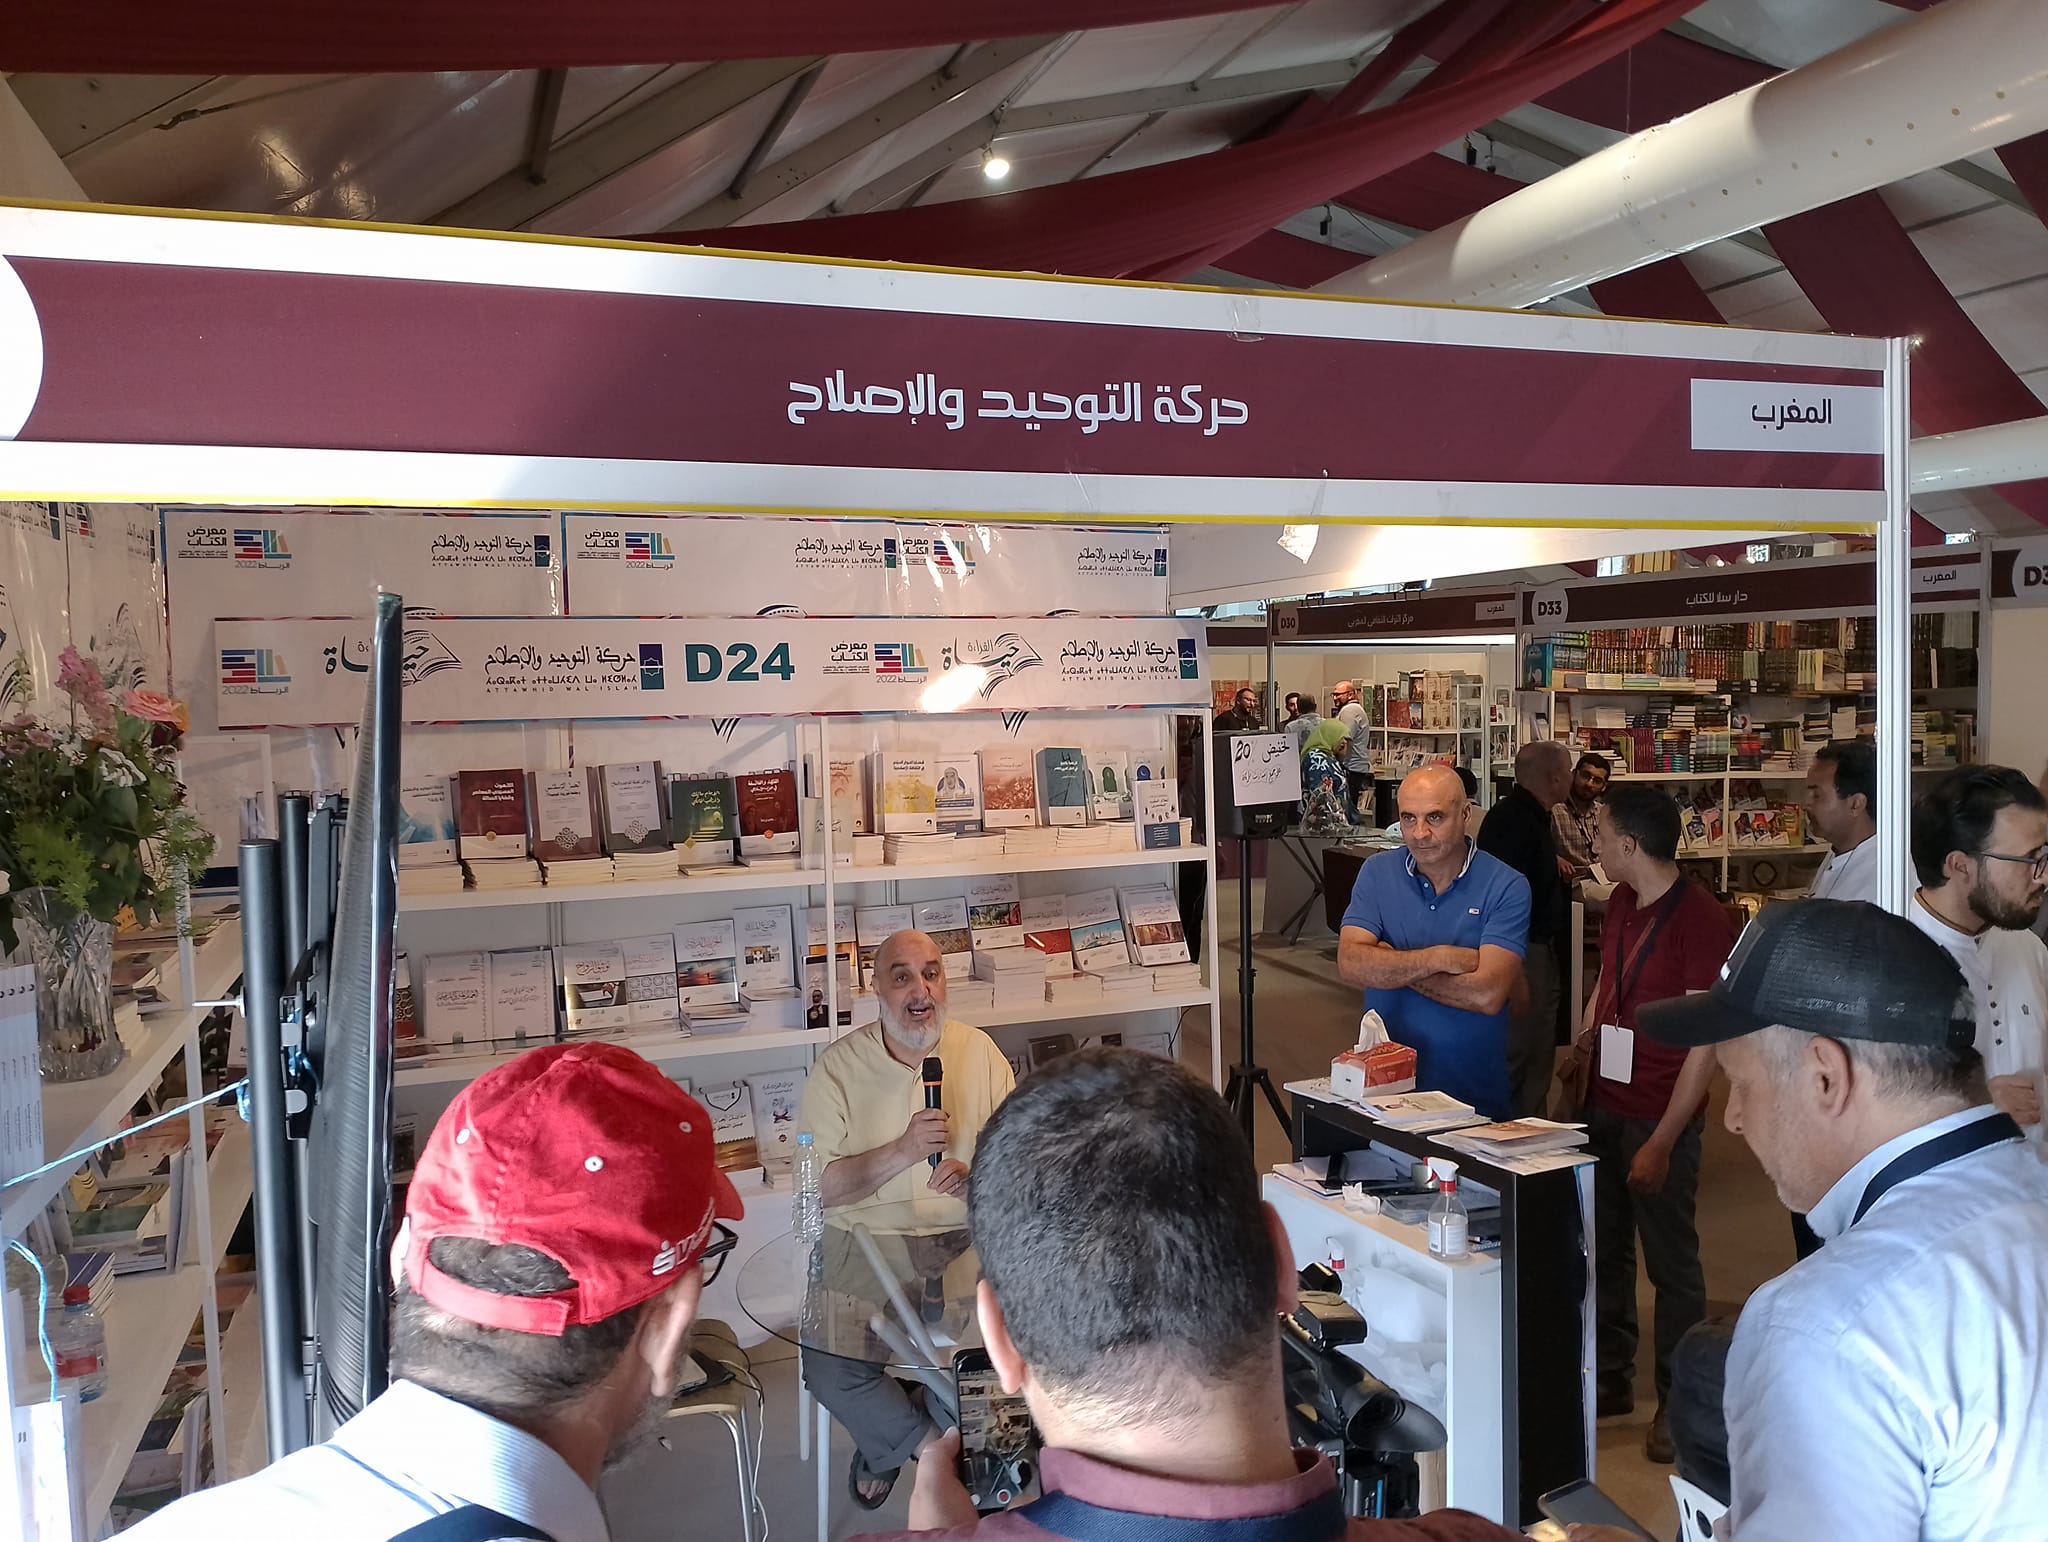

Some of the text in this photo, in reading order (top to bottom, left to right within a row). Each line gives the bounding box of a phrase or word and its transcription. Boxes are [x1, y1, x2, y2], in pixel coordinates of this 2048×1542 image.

[787, 369, 1249, 436] حركة التوحيد والإصلاح
[1751, 398, 1832, 431] المغرب
[187, 526, 227, 538] معرض
[584, 529, 619, 540] معرض
[187, 537, 227, 549] الكتاب
[473, 535, 502, 552] التوحيد
[505, 536, 532, 554] حركة
[585, 539, 620, 550] الكتاب
[831, 539, 855, 555] التوحيد
[858, 540, 882, 557] حركة
[1108, 548, 1130, 563] التوحيد
[1133, 549, 1153, 565] حركة
[1923, 570, 1957, 585] المغرب
[1732, 590, 1748, 605] دار
[1537, 600, 1562, 616] D33
[1281, 617, 1295, 629] D30
[830, 640, 868, 652] معرض
[1060, 639, 1176, 666] حركة التوحيد والإصلاح
[484, 644, 636, 675] حركة التوحيد والإصلاح
[684, 642, 796, 682] D24
[831, 651, 869, 664] الكتاب
[876, 675, 897, 683] 2022
[222, 685, 249, 695] 2022
